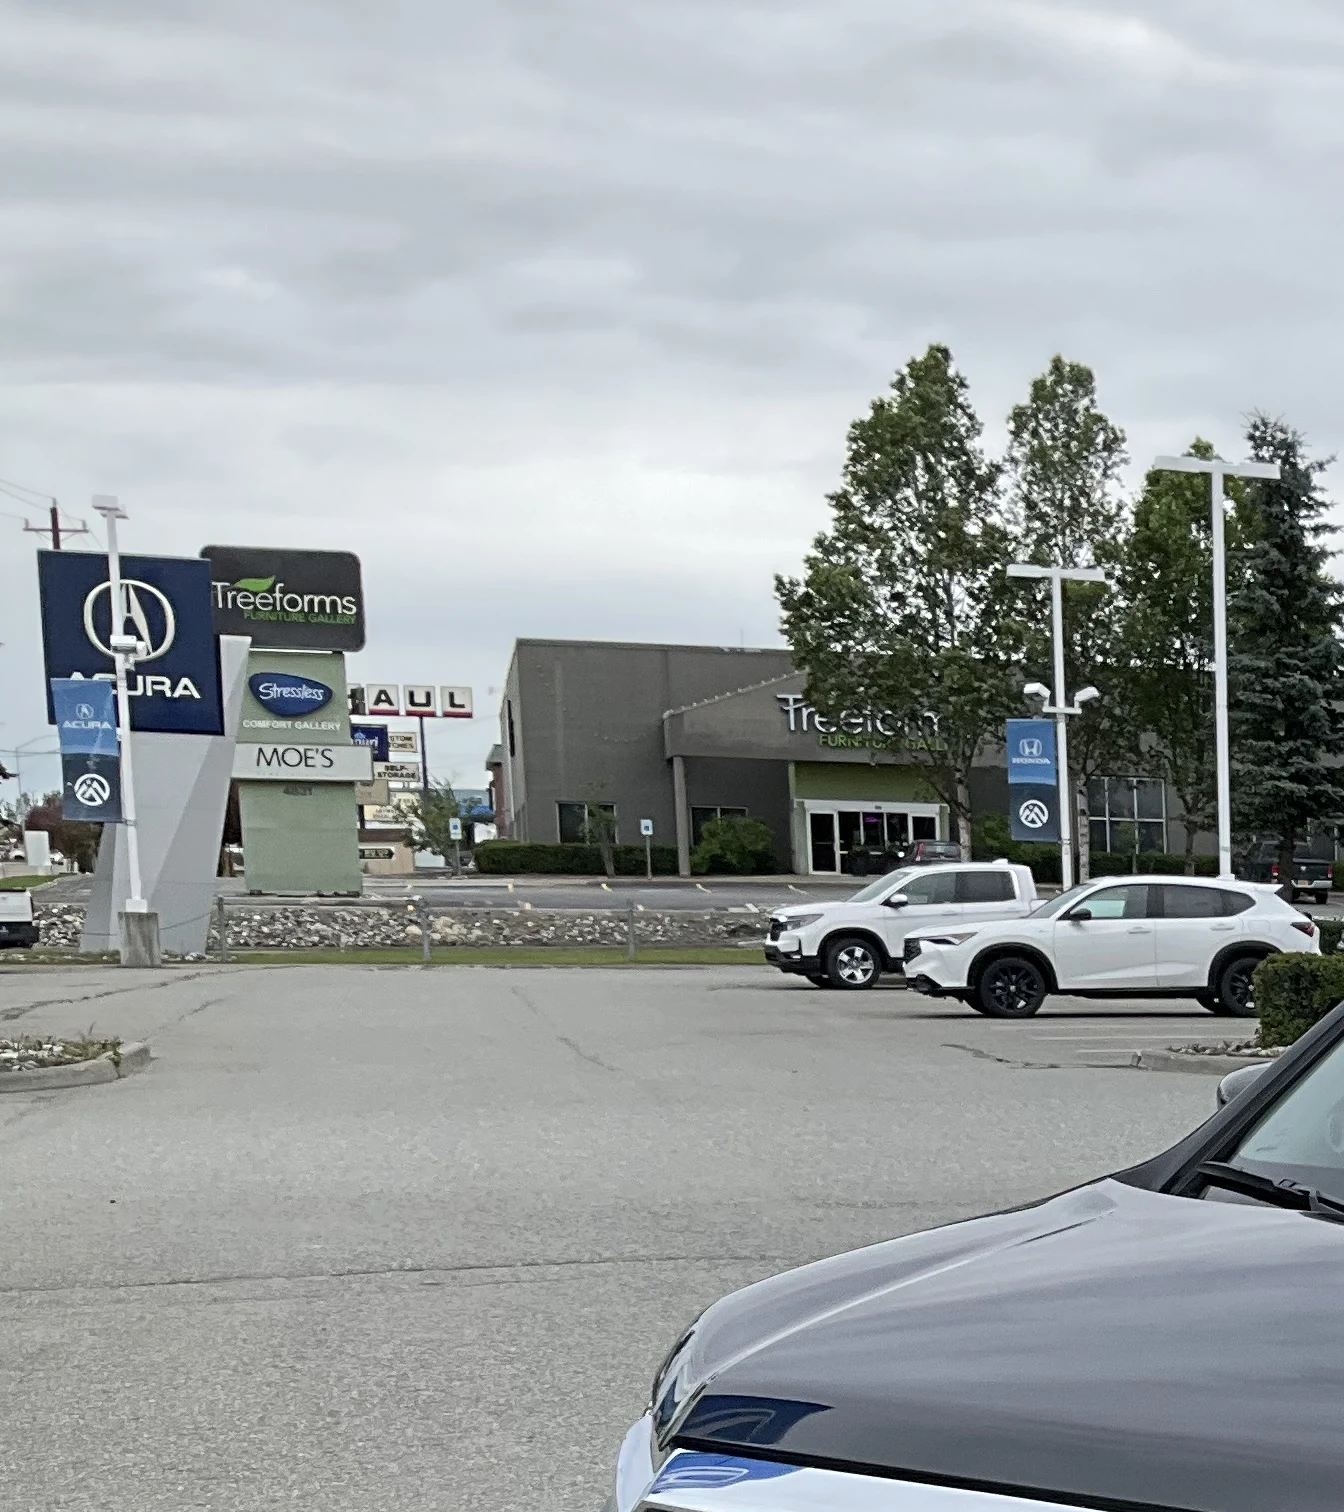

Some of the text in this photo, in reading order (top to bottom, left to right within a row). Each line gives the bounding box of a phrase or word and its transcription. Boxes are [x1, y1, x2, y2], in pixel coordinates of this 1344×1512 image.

[212, 581, 357, 615] Treeforms
[243, 611, 357, 625] FURNITURE GALLERY
[70, 671, 201, 699] URA
[259, 682, 325, 701] Stressless
[62, 719, 113, 730] ACURA
[243, 719, 341, 731] COMFORT GALLERY
[256, 747, 334, 768] MOE'S
[1011, 757, 1051, 765] HONDA
[377, 771, 416, 779] STORAGE
